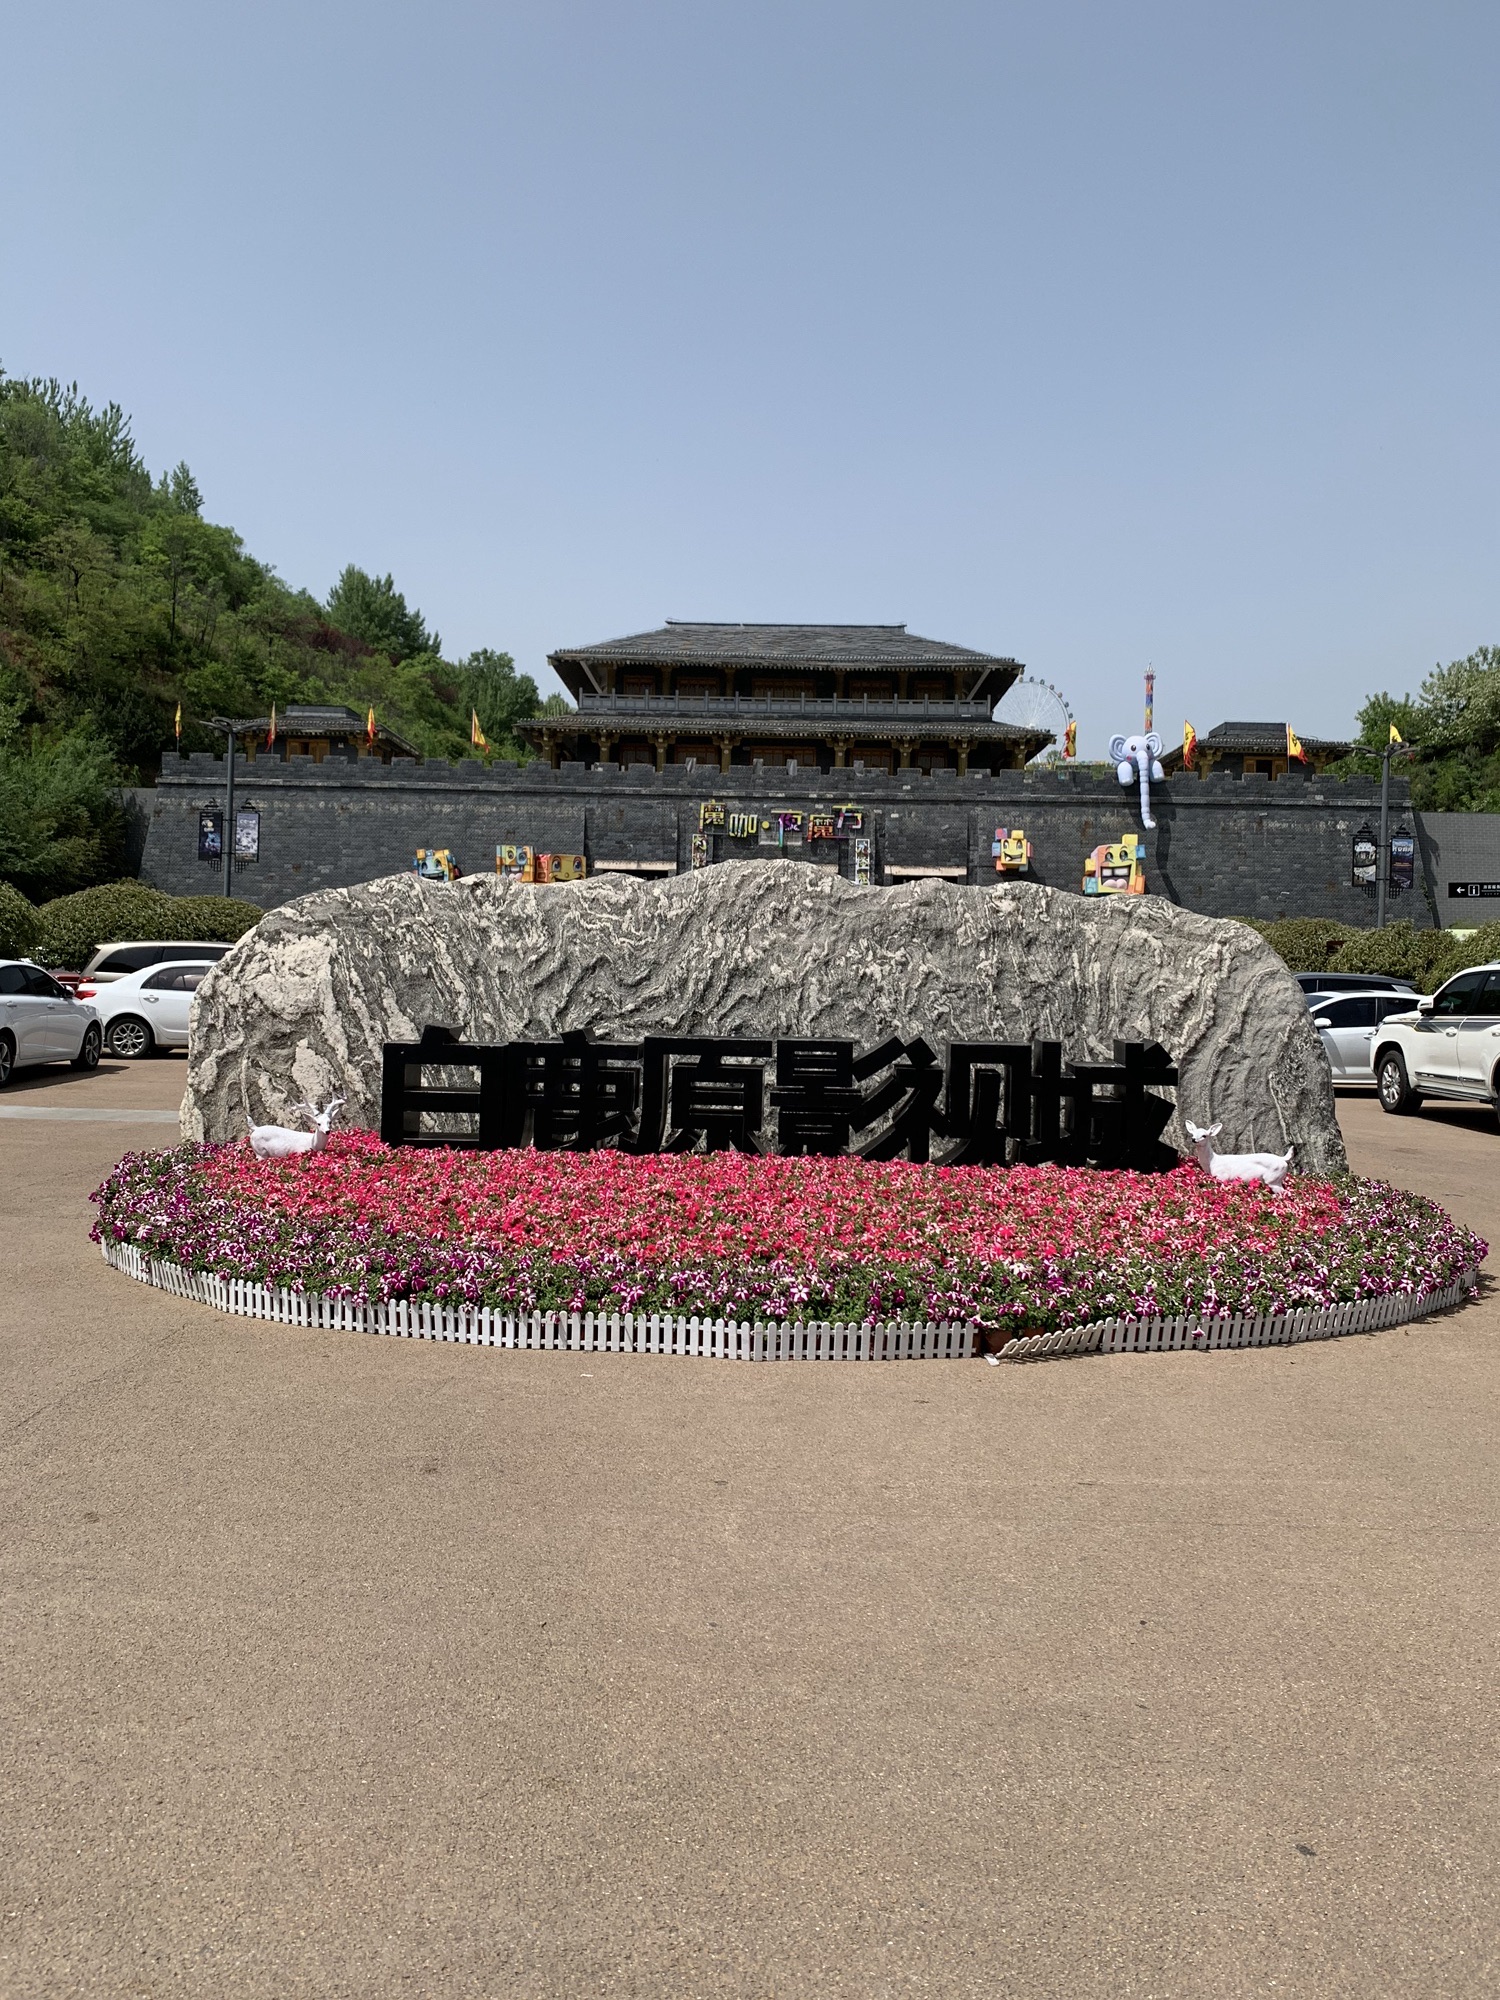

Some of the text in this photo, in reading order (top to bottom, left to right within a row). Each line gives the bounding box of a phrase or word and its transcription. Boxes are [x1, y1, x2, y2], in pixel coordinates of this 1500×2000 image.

[381, 1024, 1178, 1173] 白鹿原影视城
